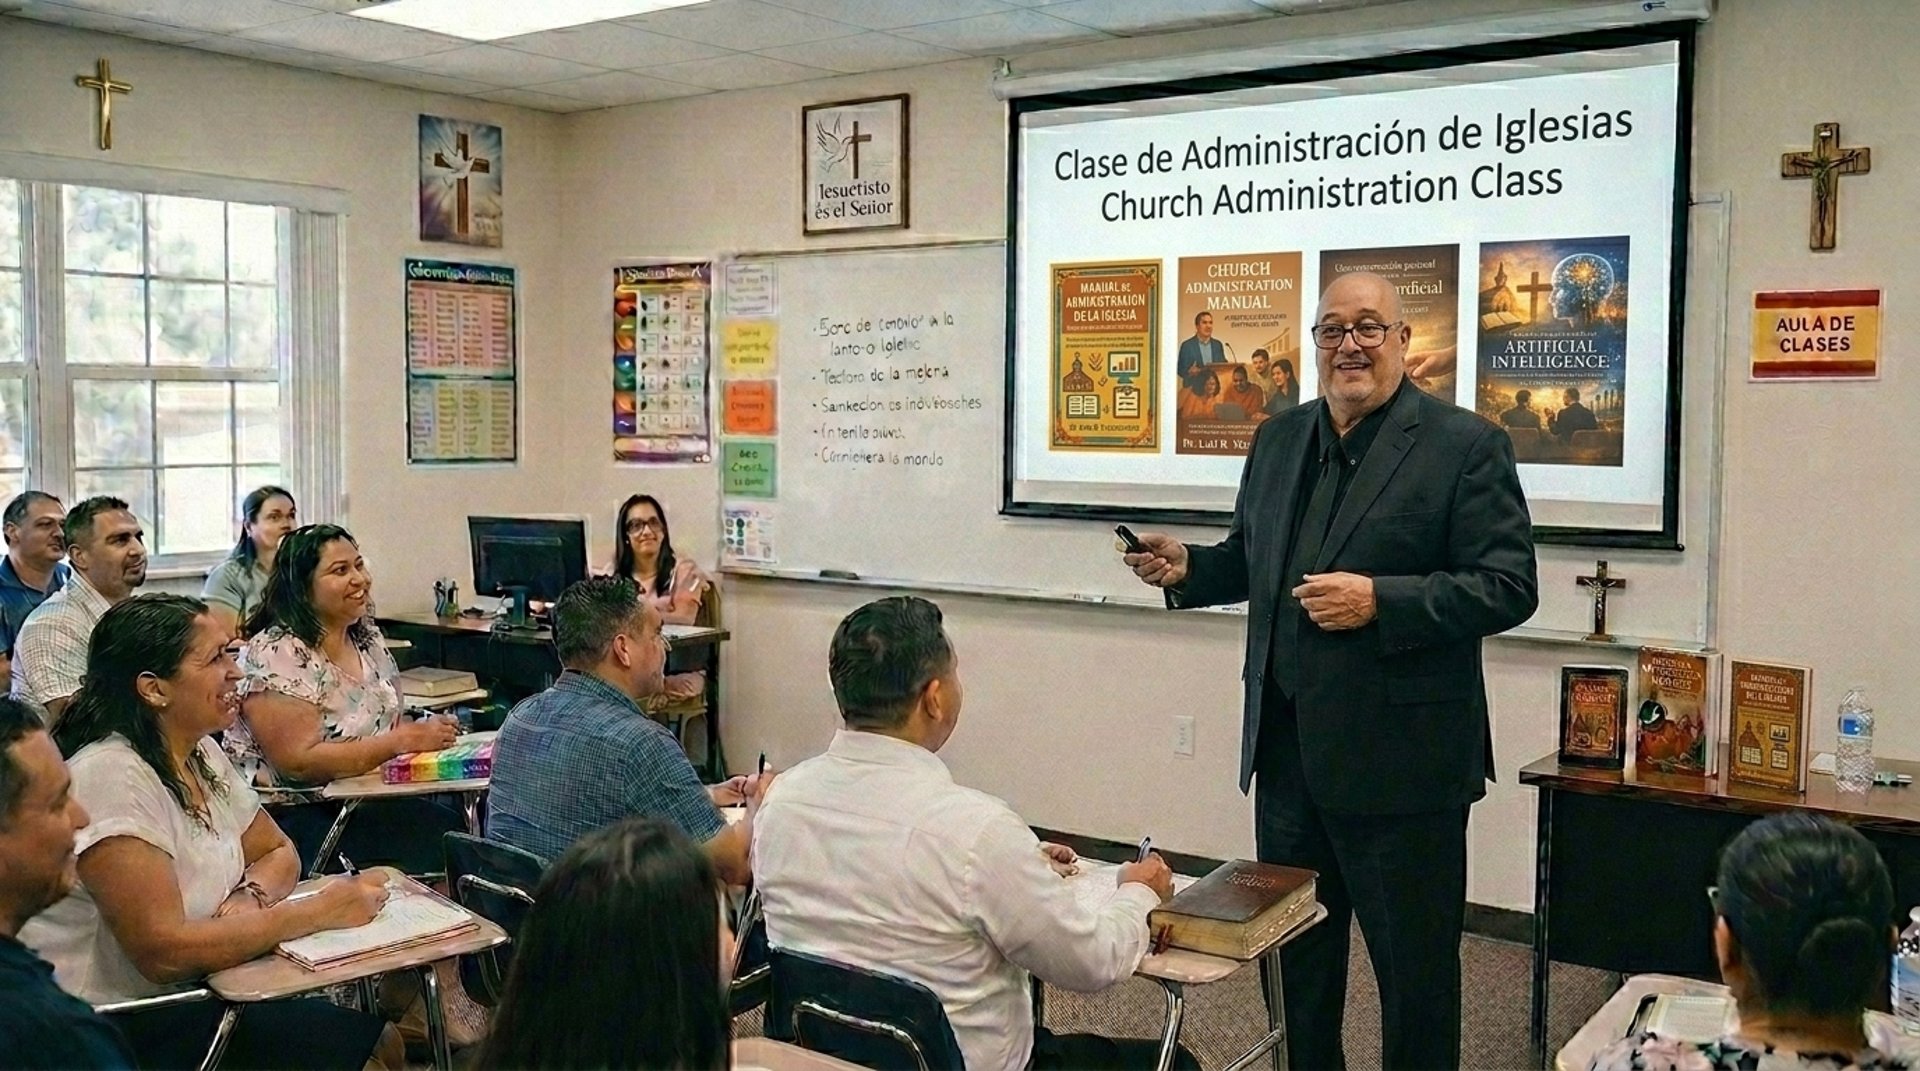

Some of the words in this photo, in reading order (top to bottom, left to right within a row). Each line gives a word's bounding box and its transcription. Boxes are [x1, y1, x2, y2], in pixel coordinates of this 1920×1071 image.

[1055, 148, 1128, 181] Clase
[1137, 142, 1173, 175] de
[1181, 119, 1425, 171] Administración
[1438, 114, 1482, 151] de
[1496, 104, 1633, 154] Iglesias
[1101, 184, 1202, 222] Church
[1212, 167, 1457, 215] Administration
[1471, 162, 1563, 199] Class
[833, 201, 846, 218] el
[1207, 295, 1272, 310] MANUAL
[856, 316, 872, 333] de
[1776, 314, 1826, 332] AULA
[1830, 315, 1855, 331] DE
[1504, 339, 1598, 353] ARTIFICIAL
[1779, 336, 1851, 353] CLASES
